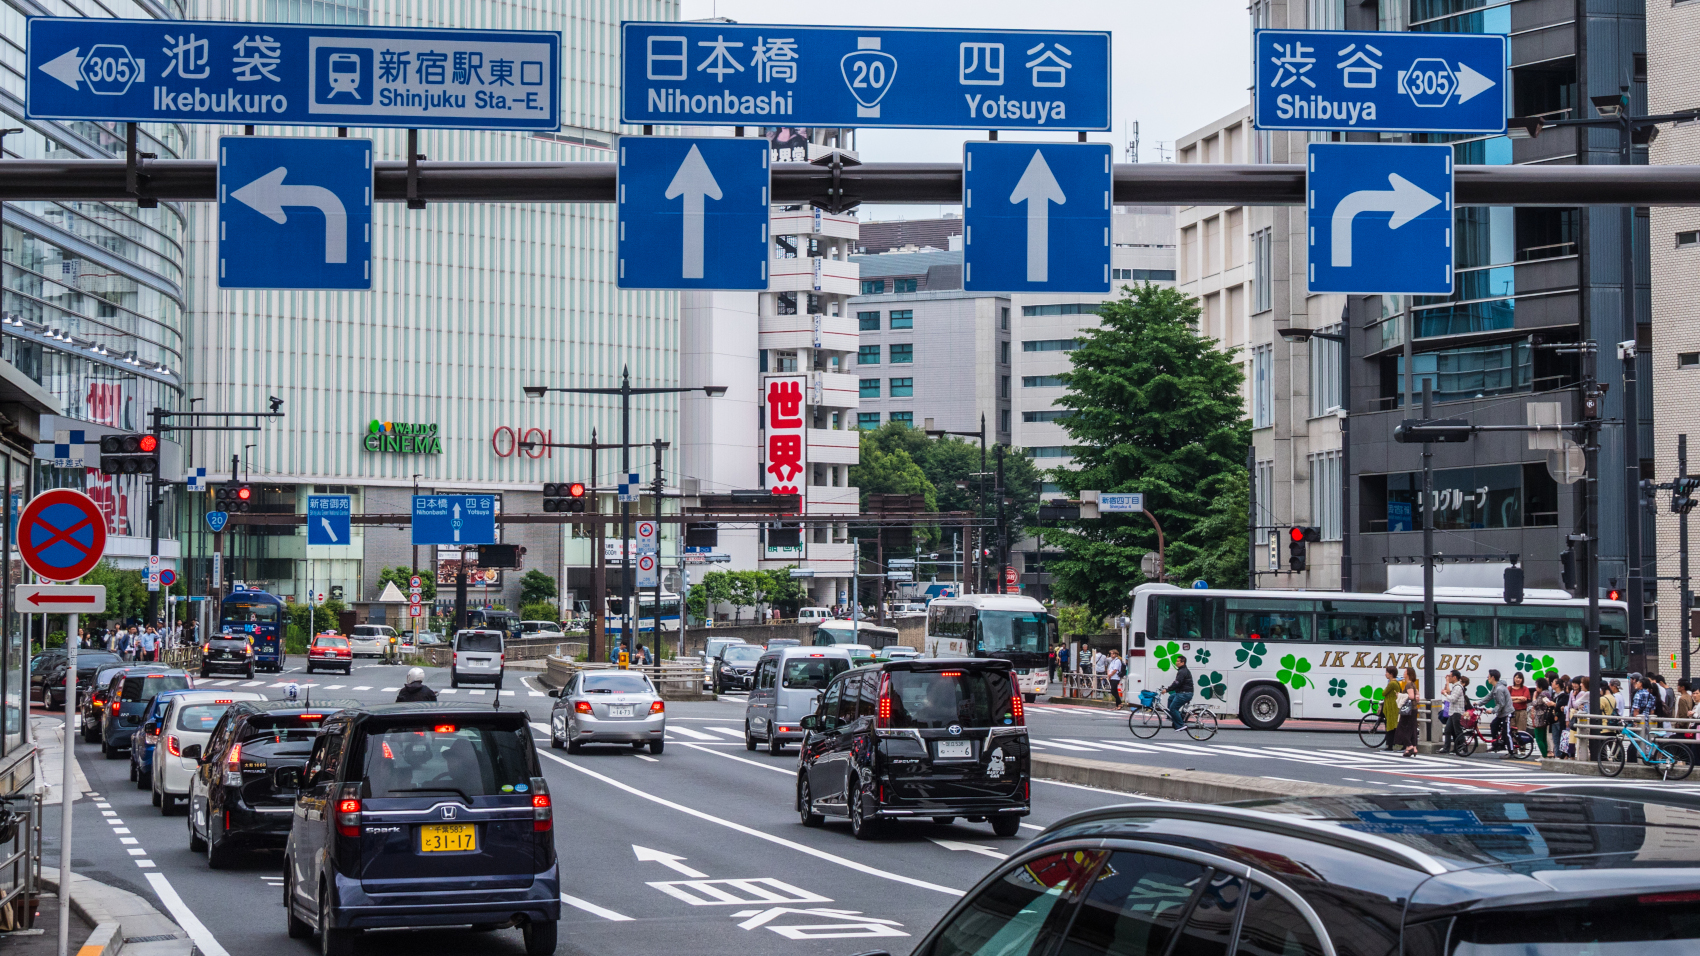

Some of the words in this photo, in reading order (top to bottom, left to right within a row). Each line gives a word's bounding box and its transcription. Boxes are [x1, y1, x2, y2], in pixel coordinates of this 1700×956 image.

[88, 57, 130, 82] 305
[162, 34, 282, 83] 池袋
[378, 49, 544, 88] 新宿駅東口
[646, 35, 800, 85] 日本橋
[959, 42, 1072, 89] 四谷
[1270, 42, 1383, 90] 渋谷
[853, 61, 885, 89] 20
[1411, 71, 1449, 96] 305
[154, 86, 288, 114] Ikebukuro
[379, 89, 466, 111] Shinjuku
[647, 88, 793, 116] Nihonbashi
[965, 94, 1066, 125] Yotsuya
[1276, 94, 1377, 125] Shibuya
[364, 434, 443, 454] CINEMA
[54, 458, 84, 468] 時差式
[310, 498, 349, 509] 新宿御苑
[416, 498, 448, 509] 日本橋
[465, 498, 490, 509] 四谷
[1102, 496, 1139, 504] 新宿四丁目
[1319, 651, 1349, 667] IK
[1436, 654, 1481, 671] BUS
[965, 747, 970, 755] 6
[434, 835, 473, 849] 31-17
[644, 877, 912, 940] 四谷
